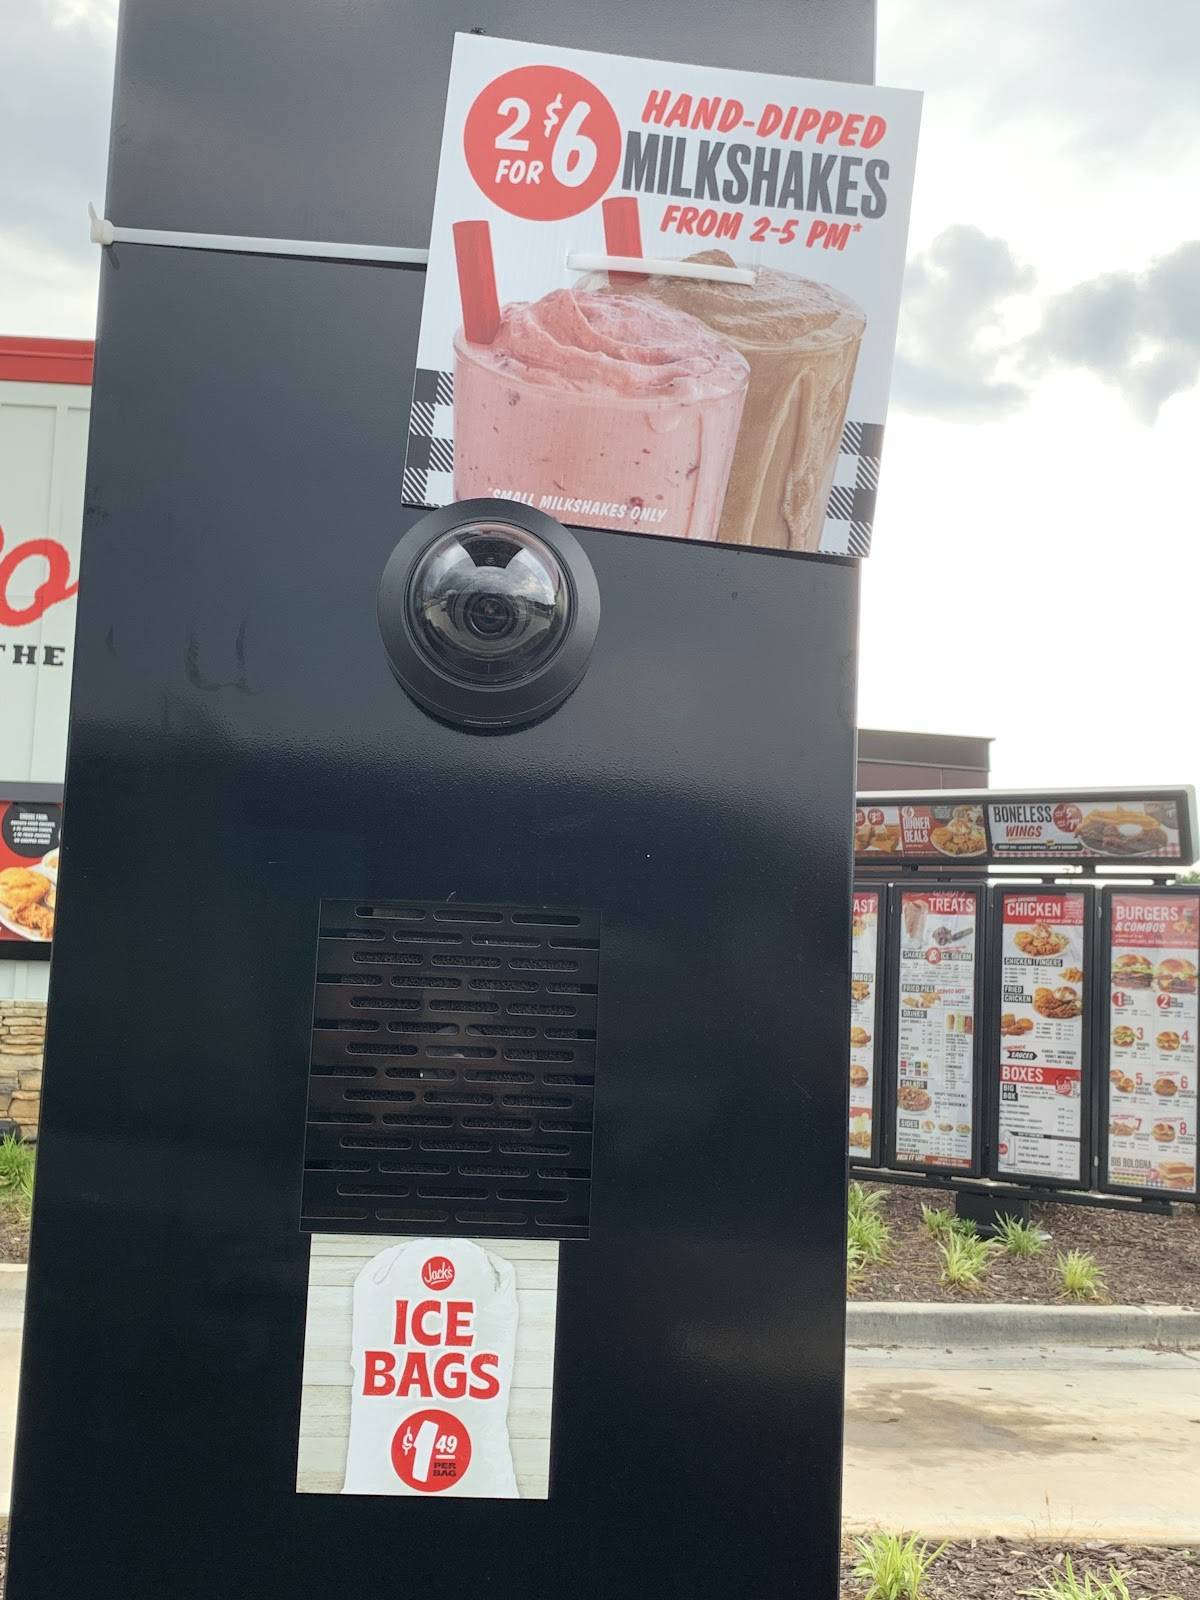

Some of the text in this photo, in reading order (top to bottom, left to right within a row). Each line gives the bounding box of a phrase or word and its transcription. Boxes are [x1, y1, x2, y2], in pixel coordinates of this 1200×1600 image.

[641, 89, 887, 150] HAND-DIPPED
[494, 92, 598, 188] 2 $6
[494, 159, 543, 185] FOR
[621, 130, 890, 220] MILKSHAKES
[660, 204, 746, 242] FROM
[749, 216, 799, 249] 2-5
[538, 495, 627, 519] MILKSHAKES
[630, 506, 668, 523] ONLY
[0, 644, 66, 667] HE
[993, 805, 1052, 823] BONELESS
[1006, 825, 1043, 838] WINGS
[928, 897, 974, 912] TREATS
[1007, 902, 1061, 917] CHICKEN
[1116, 906, 1179, 921] BURGERS
[1116, 993, 1123, 1006] 1
[1159, 995, 1169, 1008] 2
[1136, 1027, 1144, 1041] 3
[1182, 1030, 1190, 1043] 4
[1002, 1066, 1044, 1082] BOXES
[1135, 1072, 1143, 1086] 5
[1180, 1076, 1188, 1089] 6
[1179, 1121, 1187, 1135] 8
[423, 1262, 453, 1284] Jack's
[393, 1299, 475, 1347] ICE
[362, 1350, 500, 1400] BAGS
